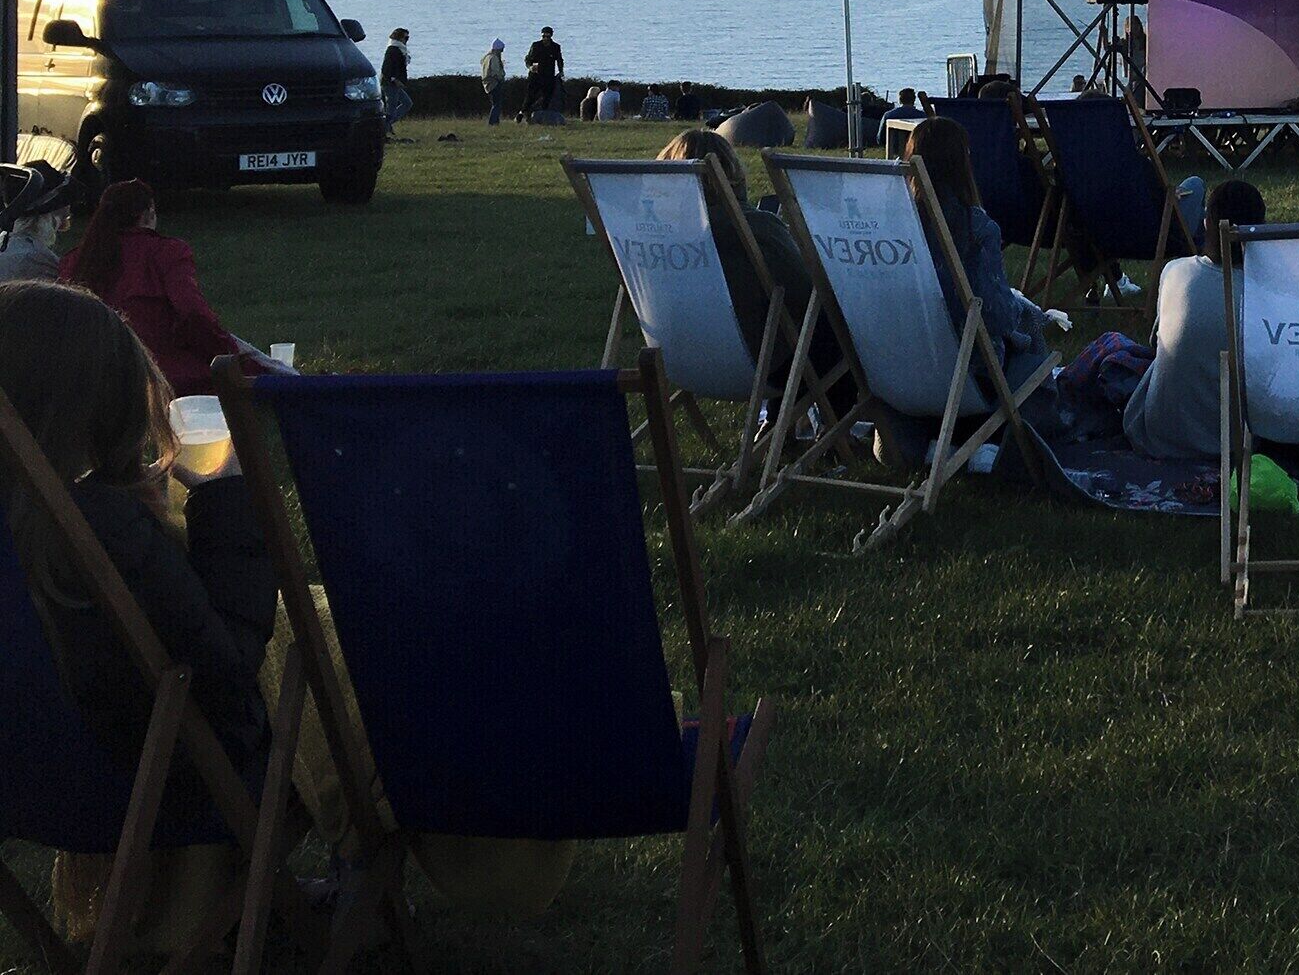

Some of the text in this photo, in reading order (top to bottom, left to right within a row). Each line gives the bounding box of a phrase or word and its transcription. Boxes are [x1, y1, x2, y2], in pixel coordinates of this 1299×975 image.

[262, 83, 287, 105] VW
[247, 153, 308, 168] RE14 JYR
